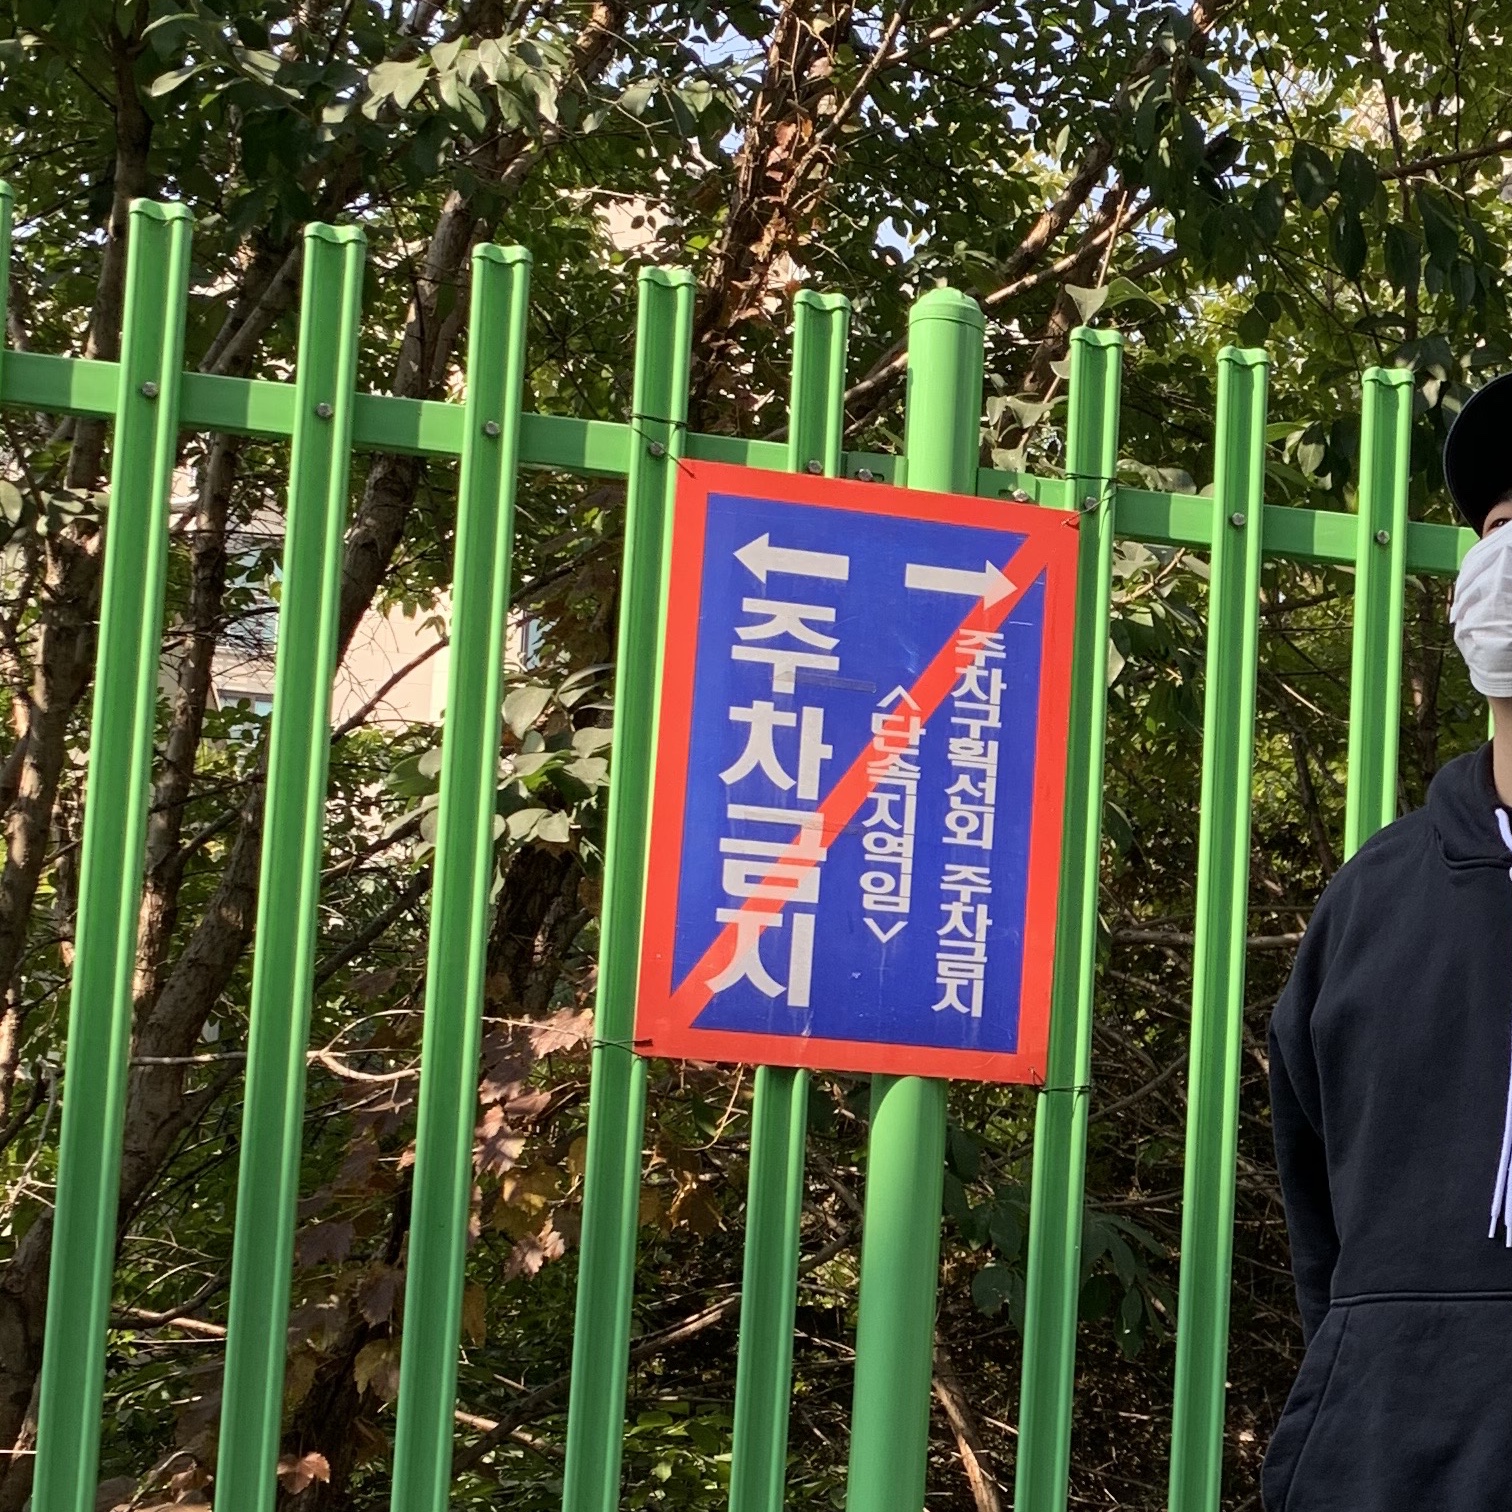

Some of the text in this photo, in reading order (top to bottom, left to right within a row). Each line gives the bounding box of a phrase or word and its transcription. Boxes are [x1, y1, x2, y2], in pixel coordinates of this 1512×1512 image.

[704, 596, 841, 1008] 주차금지
[932, 628, 1008, 1018] 주차구획선외 주차금지
